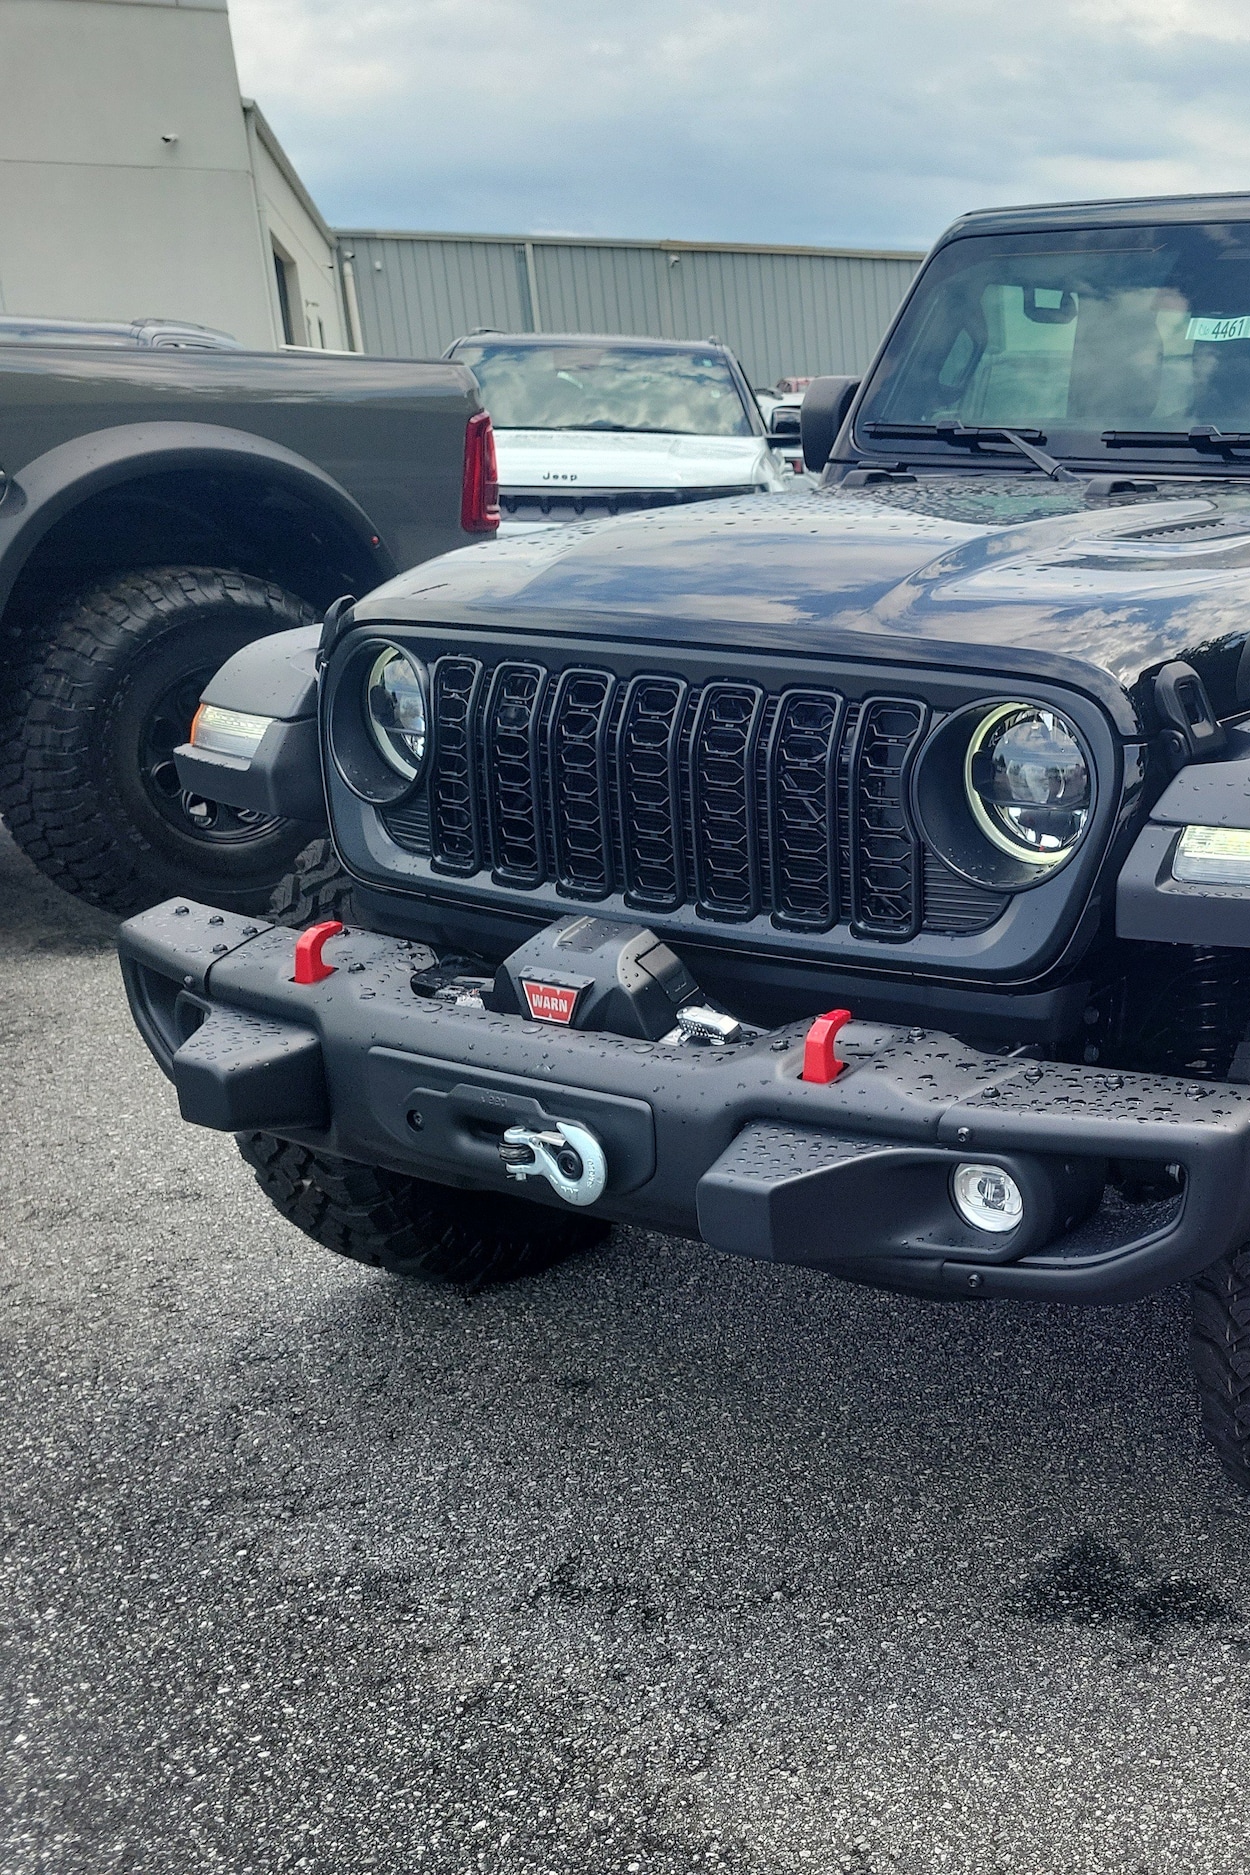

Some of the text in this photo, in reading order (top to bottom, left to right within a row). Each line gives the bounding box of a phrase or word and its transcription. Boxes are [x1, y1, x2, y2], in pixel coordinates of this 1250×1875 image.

[1211, 318, 1245, 339] 4461
[542, 472, 578, 482] Jeep
[531, 993, 568, 1013] WARN
